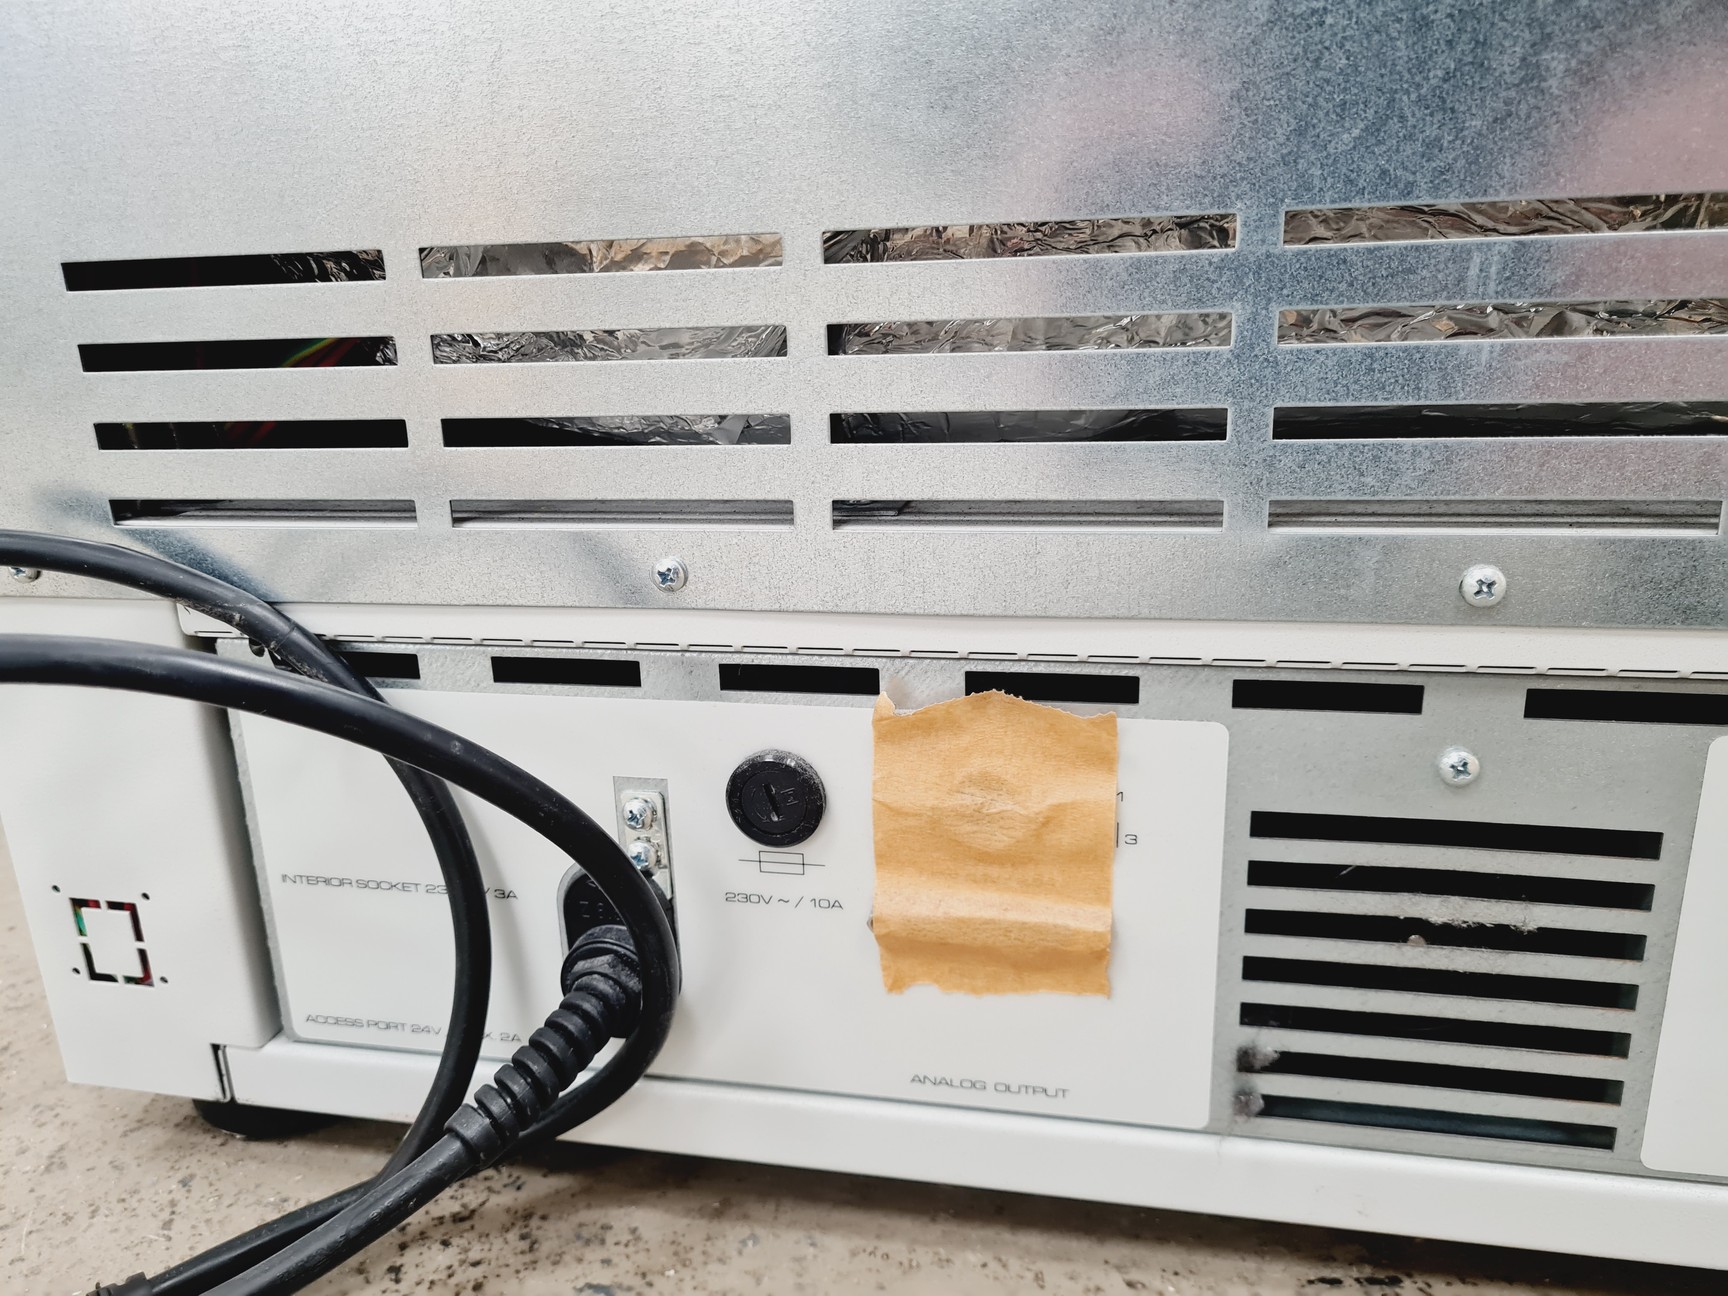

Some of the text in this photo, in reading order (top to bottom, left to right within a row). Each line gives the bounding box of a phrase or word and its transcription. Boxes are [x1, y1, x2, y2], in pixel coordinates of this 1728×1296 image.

[1124, 833, 1138, 845] 3
[281, 873, 354, 888] INTERIOR
[355, 879, 421, 893] SOCKET
[494, 888, 518, 900] 3A
[724, 891, 773, 905] 230V
[809, 897, 844, 910] 10A
[305, 1014, 365, 1028] ACCESS
[366, 1019, 408, 1033] PORT
[411, 1023, 442, 1036] 24V
[500, 1032, 522, 1043] 2A
[910, 1073, 1070, 1098] ANALOG OUTPUT
